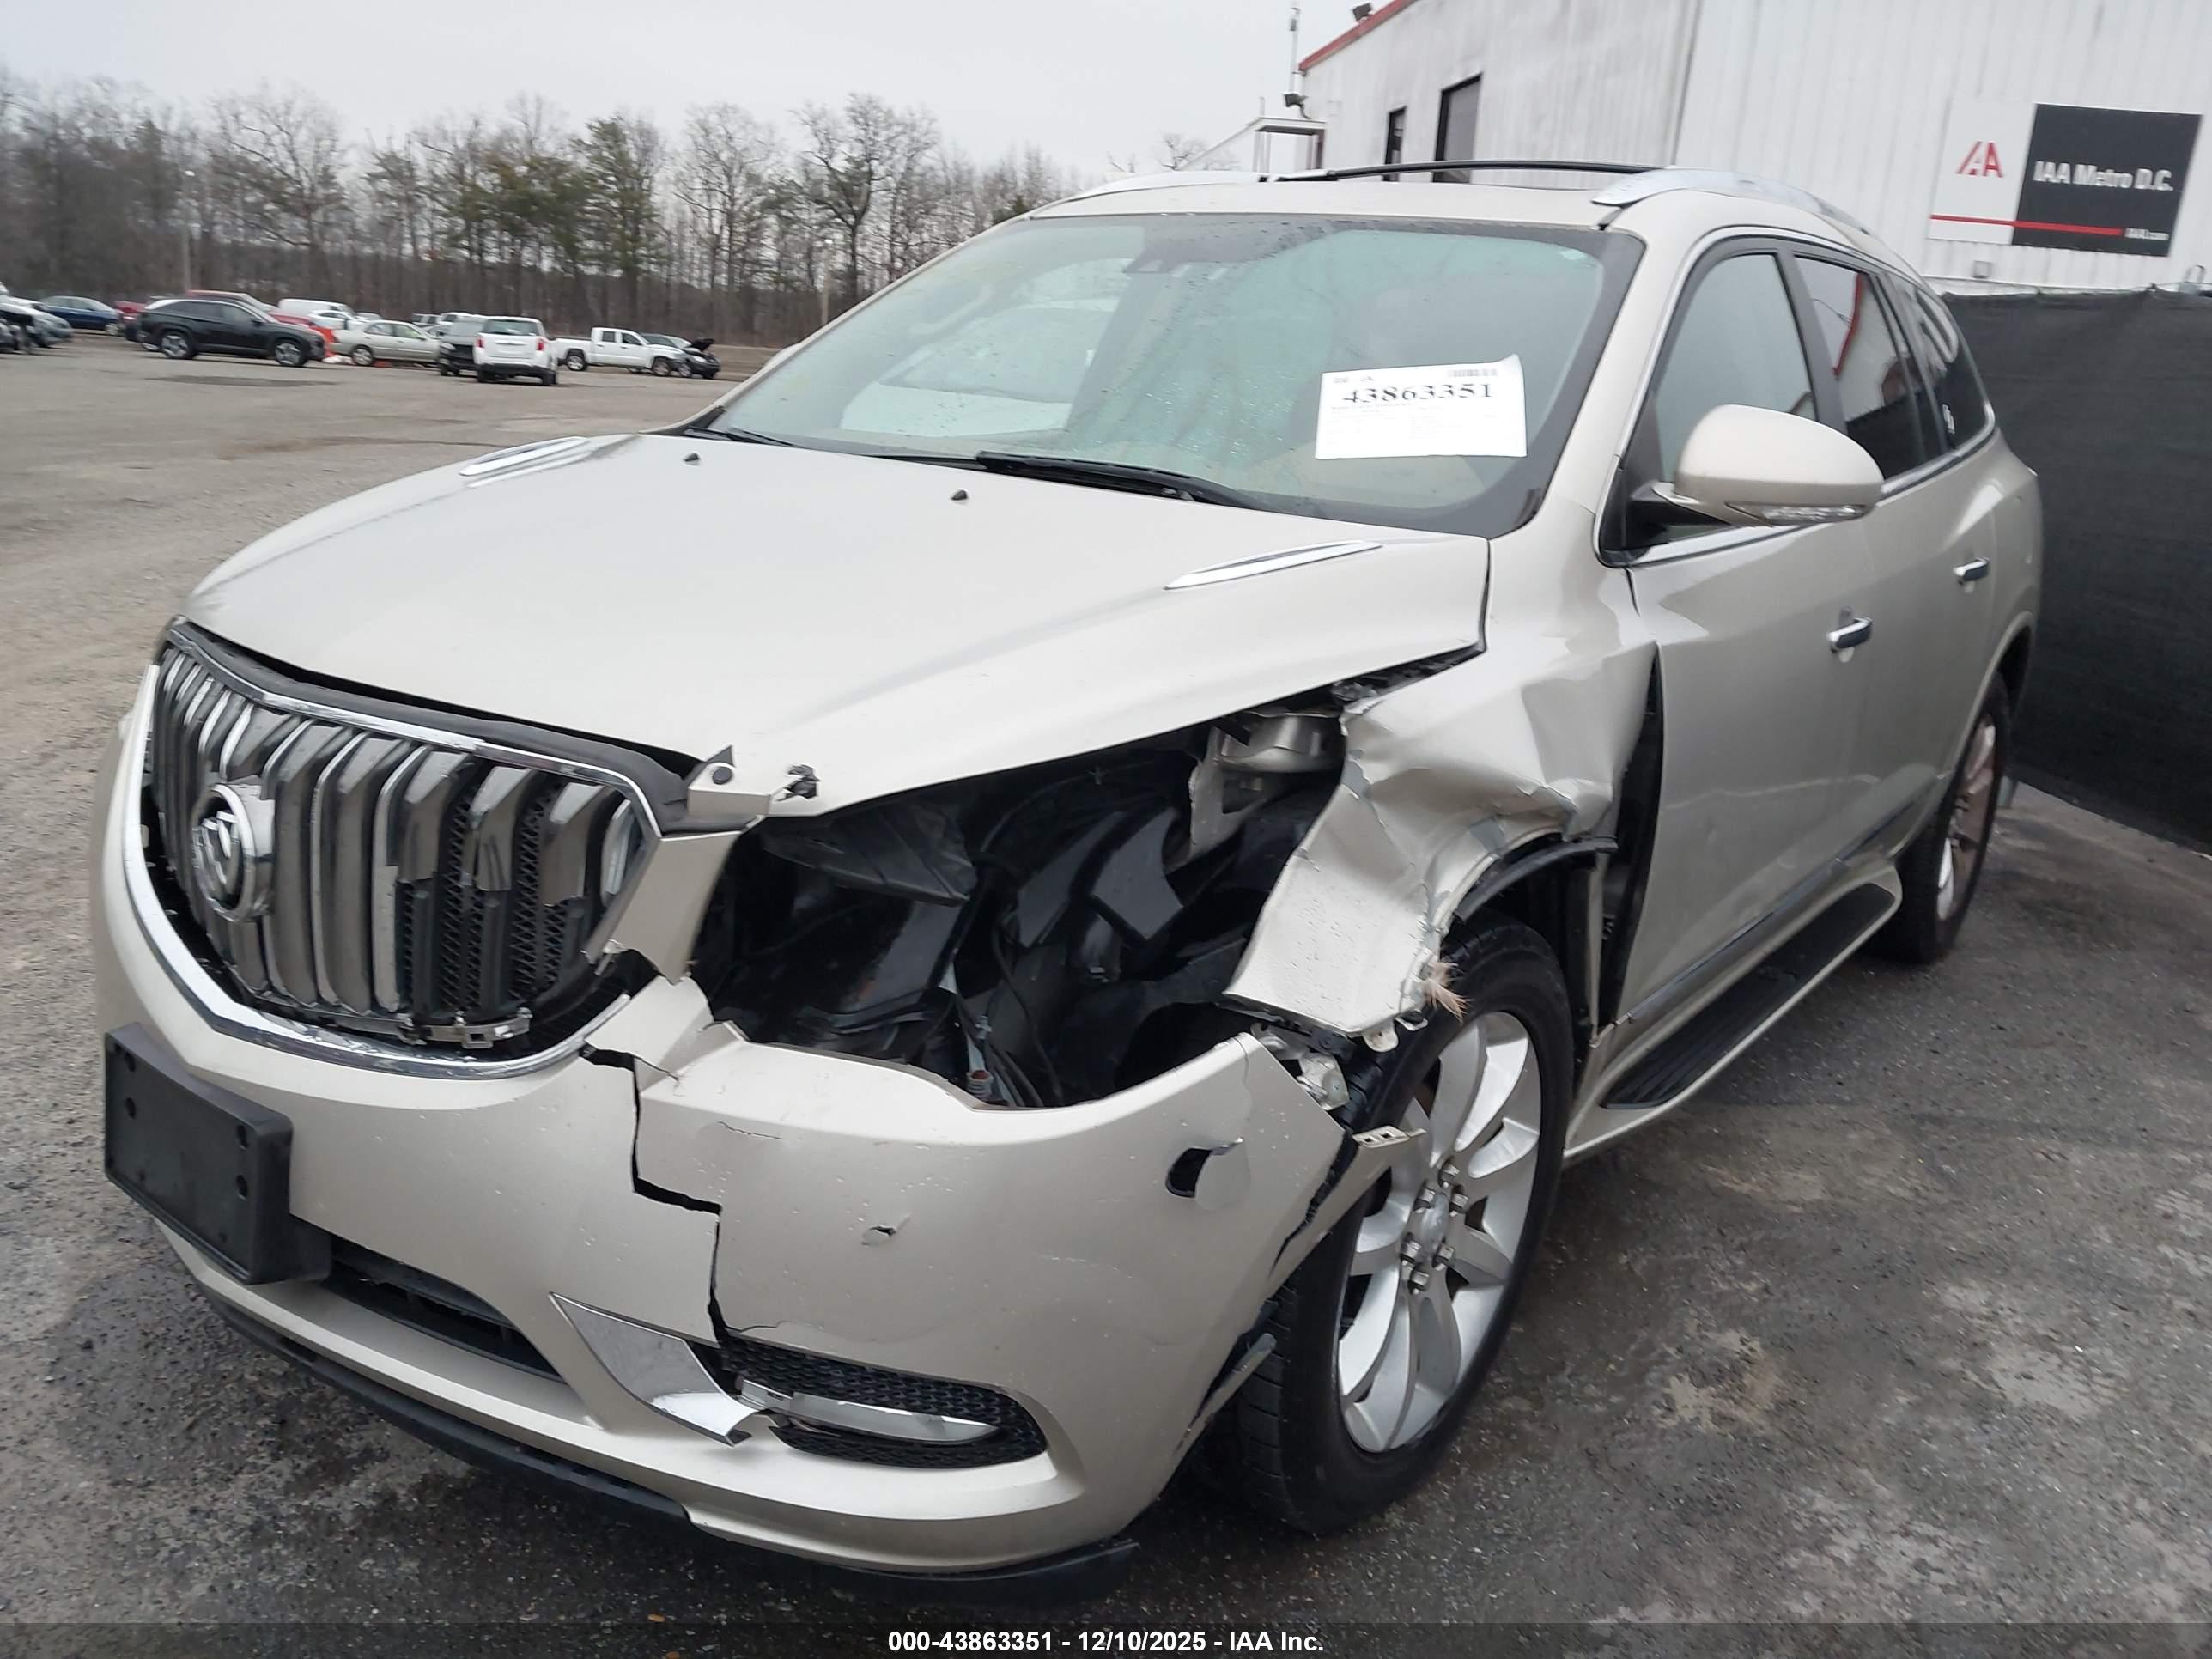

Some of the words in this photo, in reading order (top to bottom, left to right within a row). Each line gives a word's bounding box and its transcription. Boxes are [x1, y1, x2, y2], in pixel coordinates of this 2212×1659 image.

[2033, 161, 2070, 183] IAA
[2073, 164, 2132, 188] Metro
[2135, 168, 2173, 191] D.C.
[1344, 383, 1492, 404] 43863351
